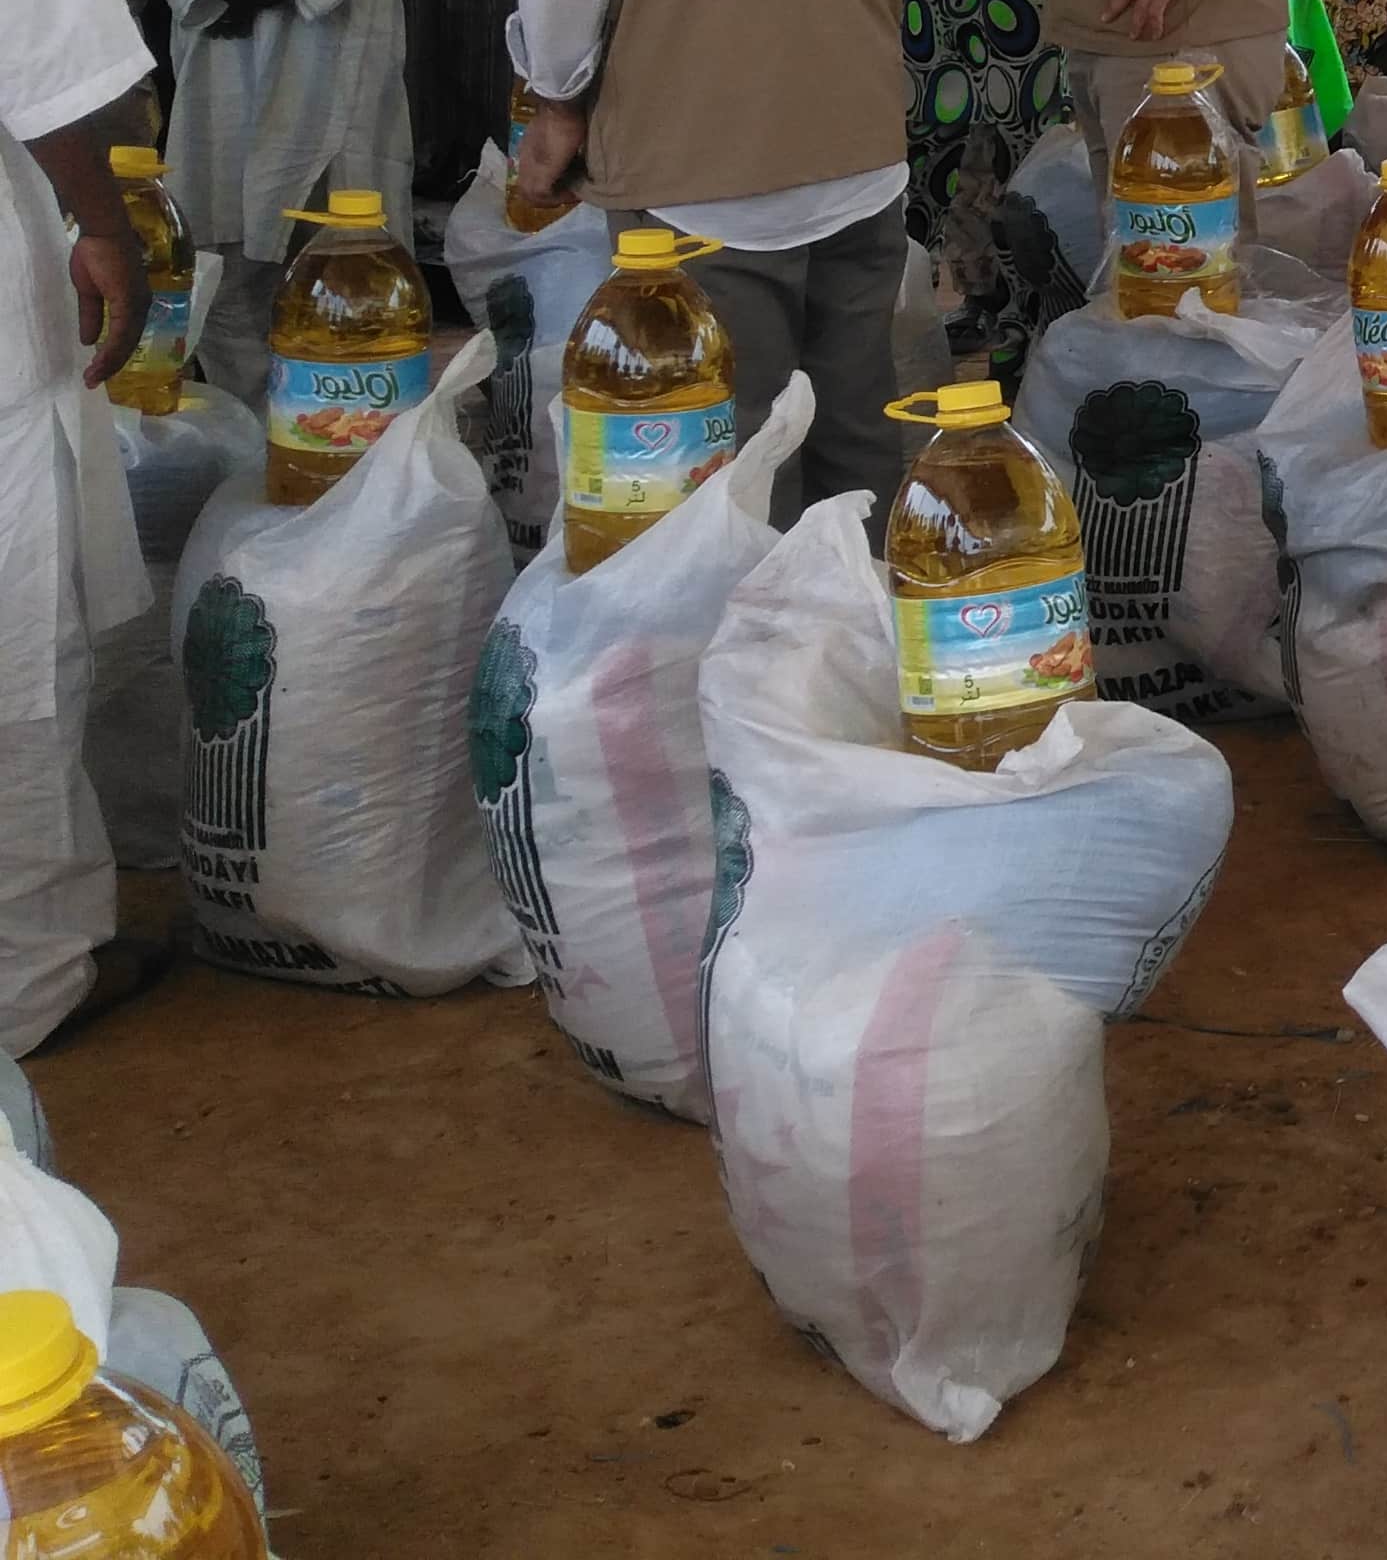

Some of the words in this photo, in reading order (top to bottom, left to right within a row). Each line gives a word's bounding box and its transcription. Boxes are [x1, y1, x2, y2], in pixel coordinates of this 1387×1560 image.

[313, 362, 400, 408] أوليور
[632, 480, 641, 492] 5
[1089, 597, 1169, 621] ÜDÂYİ
[964, 675, 974, 689] 5
